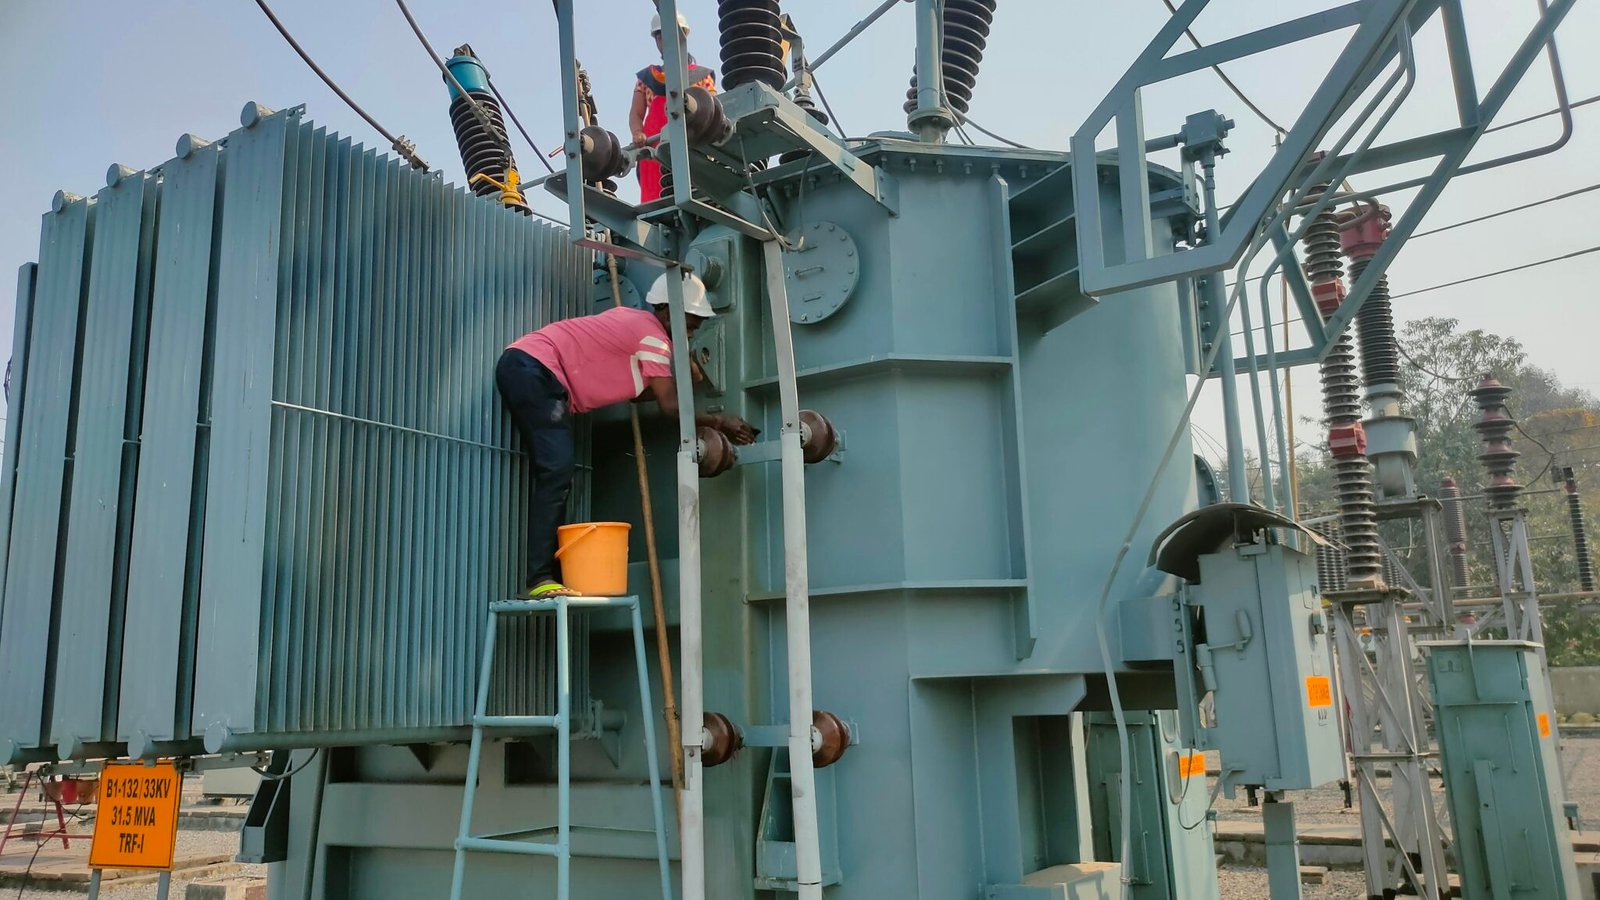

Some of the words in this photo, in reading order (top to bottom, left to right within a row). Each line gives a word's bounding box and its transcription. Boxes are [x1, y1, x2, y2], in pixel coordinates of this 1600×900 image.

[112, 806, 132, 826] 31.5
[134, 806, 155, 826] MVA
[119, 833, 145, 854] TRF-I
